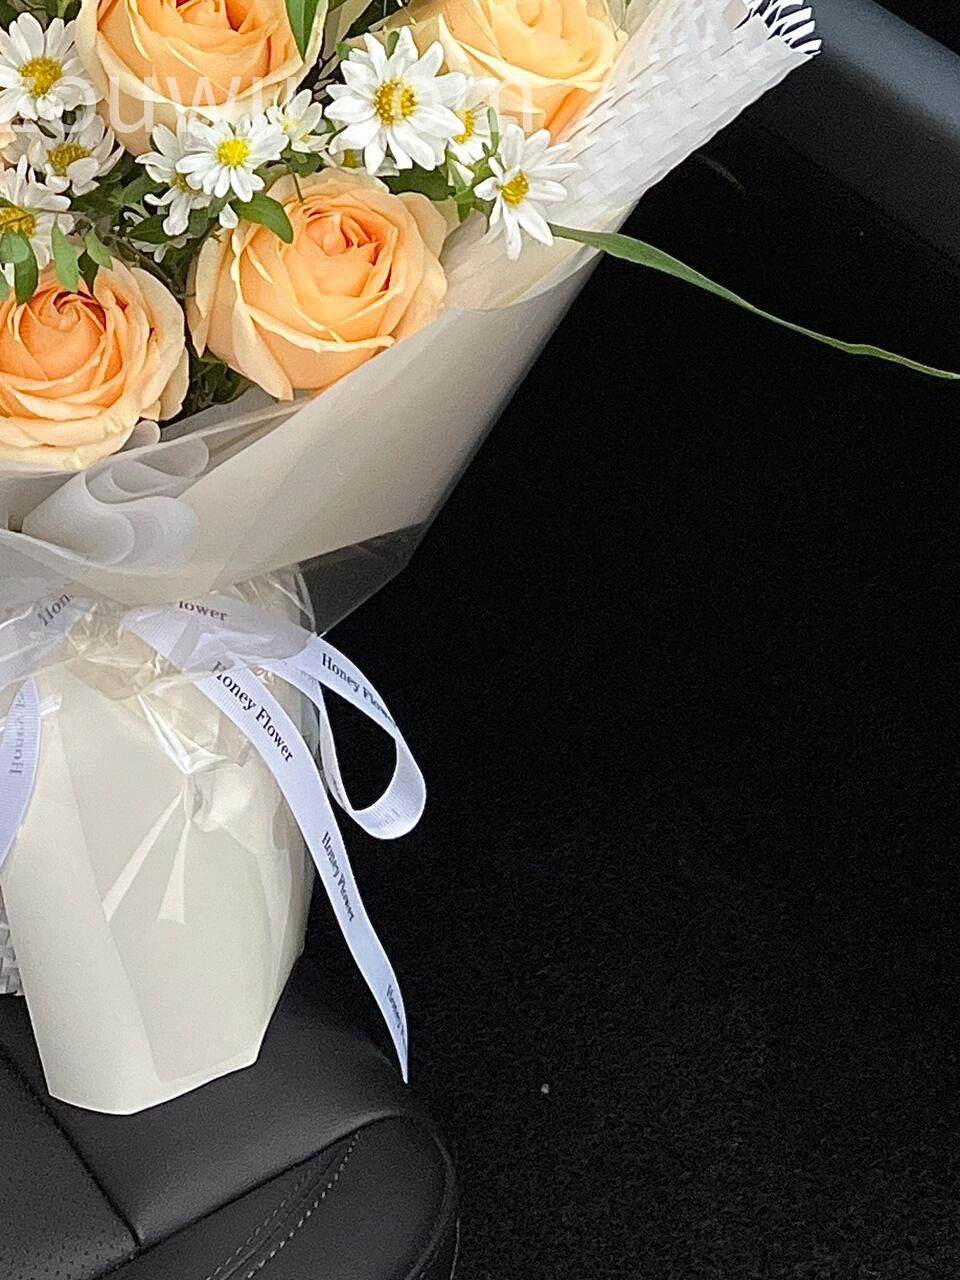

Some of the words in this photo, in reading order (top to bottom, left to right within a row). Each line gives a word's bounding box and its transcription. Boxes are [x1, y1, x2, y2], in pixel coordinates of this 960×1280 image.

[37, 593, 73, 626] Hon
[178, 600, 228, 621] lower
[321, 653, 360, 692] Honey
[256, 706, 293, 763] Flower
